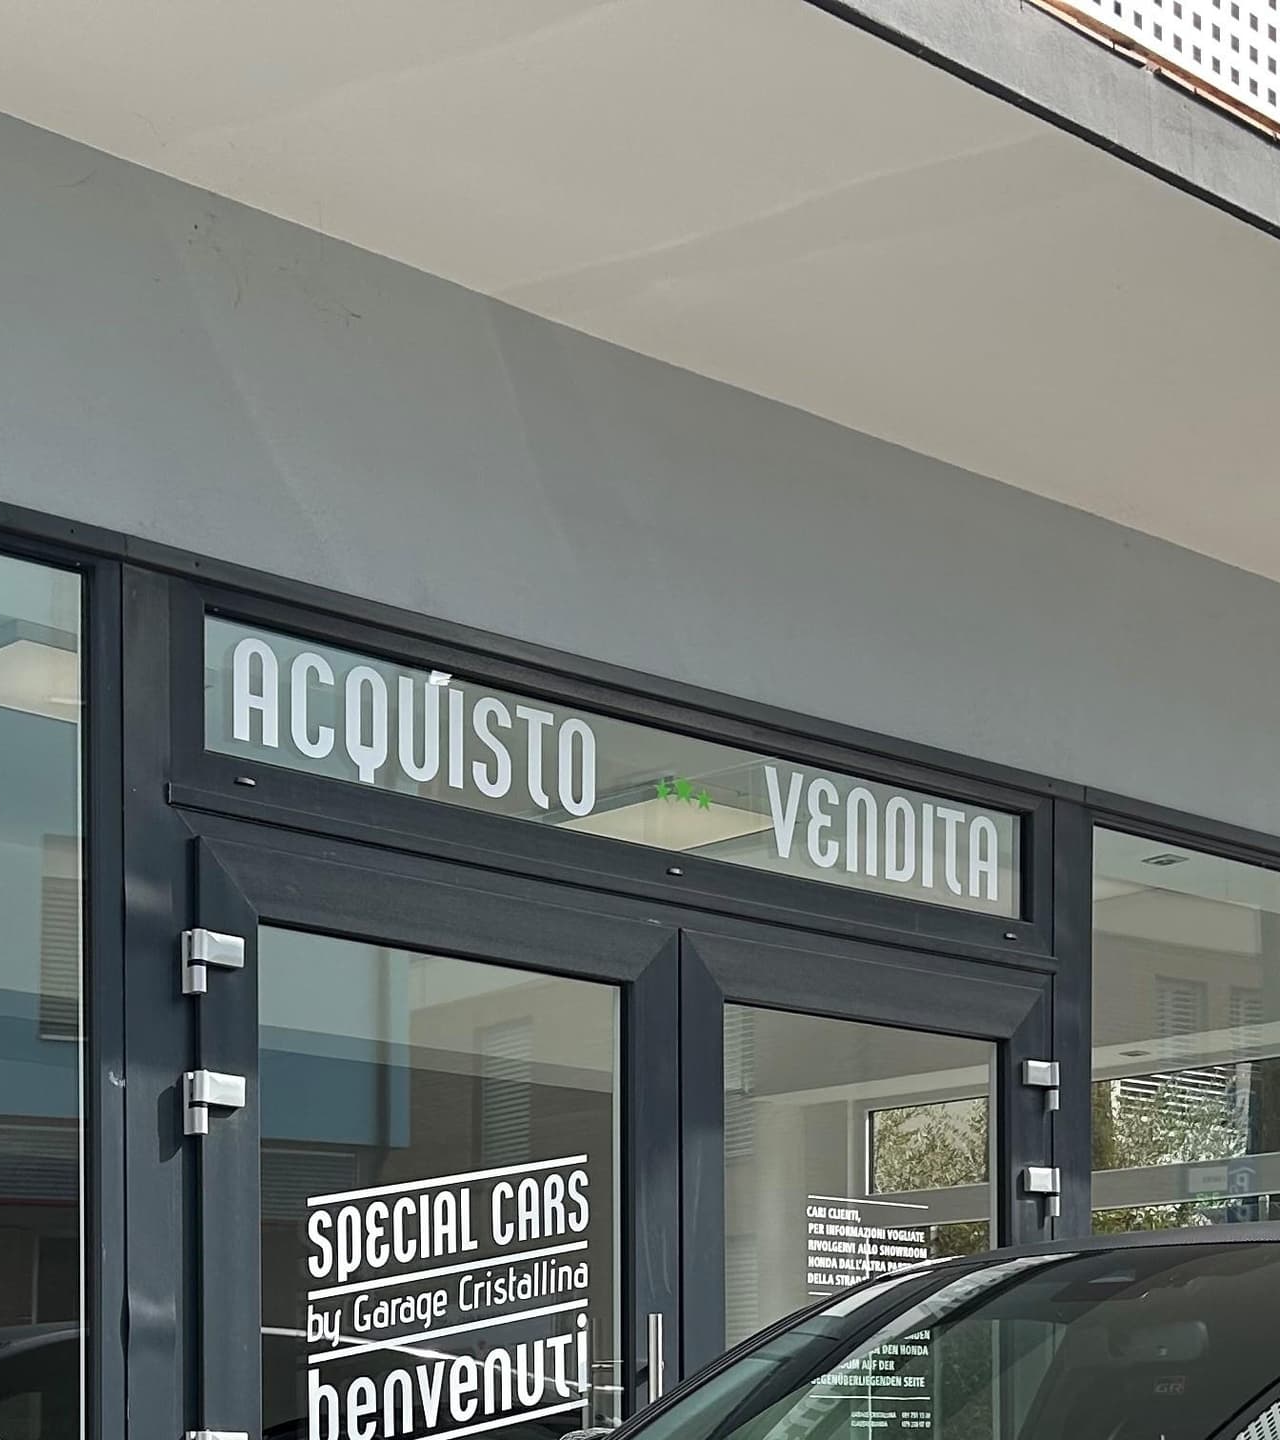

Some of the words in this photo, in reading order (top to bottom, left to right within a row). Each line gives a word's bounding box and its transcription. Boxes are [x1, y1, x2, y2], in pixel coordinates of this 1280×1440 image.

[231, 637, 598, 817] ACQUISTO
[764, 765, 999, 902] VENDITA
[807, 1206, 826, 1218] CARI
[307, 1187, 478, 1282] SPECIAL
[491, 1170, 590, 1246] CARS
[808, 1223, 824, 1235] PER
[825, 1224, 886, 1240] INFORMAZIONI
[887, 1229, 926, 1243] VOGLIATE
[808, 1240, 856, 1253] RIVOLGERVI
[880, 1245, 927, 1259] SHOWROOM
[808, 1256, 837, 1270] HONDA
[807, 1272, 834, 1285] DELLA
[307, 1304, 342, 1348] by
[354, 1289, 448, 1329] Garage
[459, 1260, 589, 1311] Cristallina
[900, 1344, 928, 1356] HONDA
[879, 1360, 895, 1371] DER
[903, 1377, 926, 1388] SEITE
